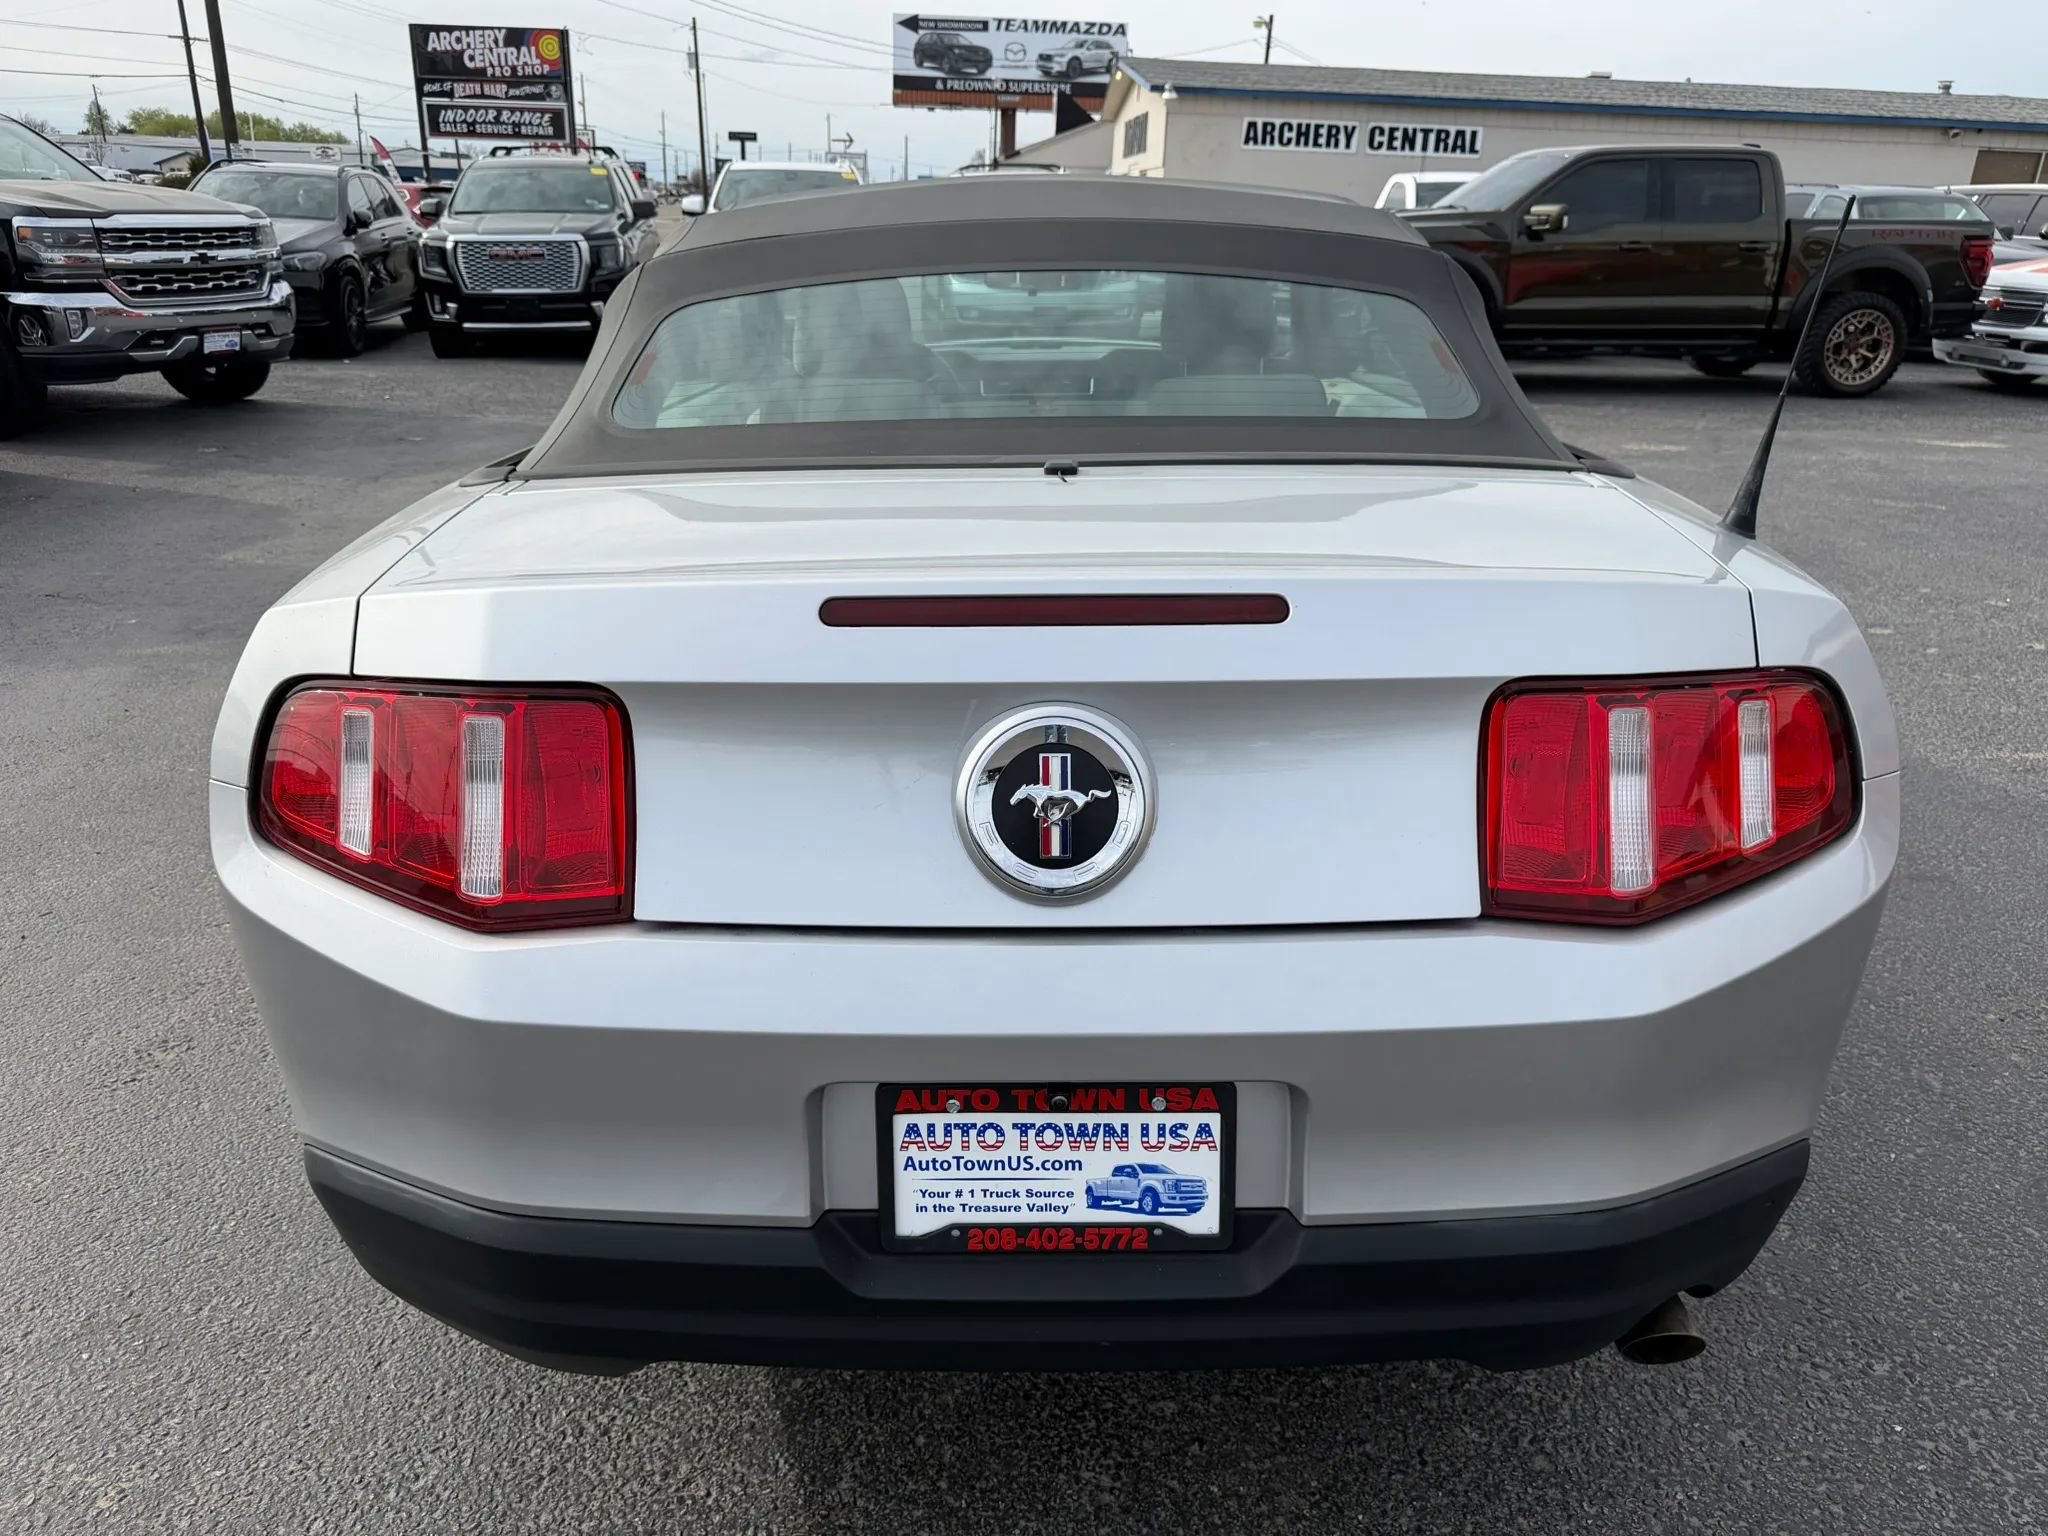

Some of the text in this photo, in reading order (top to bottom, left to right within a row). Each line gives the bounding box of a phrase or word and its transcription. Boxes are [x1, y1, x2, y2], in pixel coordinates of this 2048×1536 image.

[427, 29, 506, 52] ARCHERY
[463, 46, 541, 69] CENTRAL
[486, 64, 550, 77] PRO SHOP
[453, 82, 481, 98] DEATH
[946, 79, 1007, 92] PREOWND
[438, 108, 553, 126] INDOOR RANGE
[439, 123, 554, 136] SALES SERVICE REPAIR
[1243, 121, 1480, 155] ARCHERY CENTRAL
[895, 1088, 1001, 1112] AUTO
[1138, 1087, 1220, 1111] USA
[899, 1122, 1219, 1152] AUTO TOWN USA
[903, 1155, 1083, 1173] AutoTownUS.com
[955, 1188, 964, 1199] #
[968, 1188, 975, 1199] 1
[981, 1188, 1021, 1199] Truck
[1025, 1188, 1075, 1199] Source
[915, 1203, 928, 1213] in
[932, 1203, 955, 1213] the
[959, 1203, 1026, 1213] Treasure
[966, 1227, 1149, 1251] 208-402-5772
